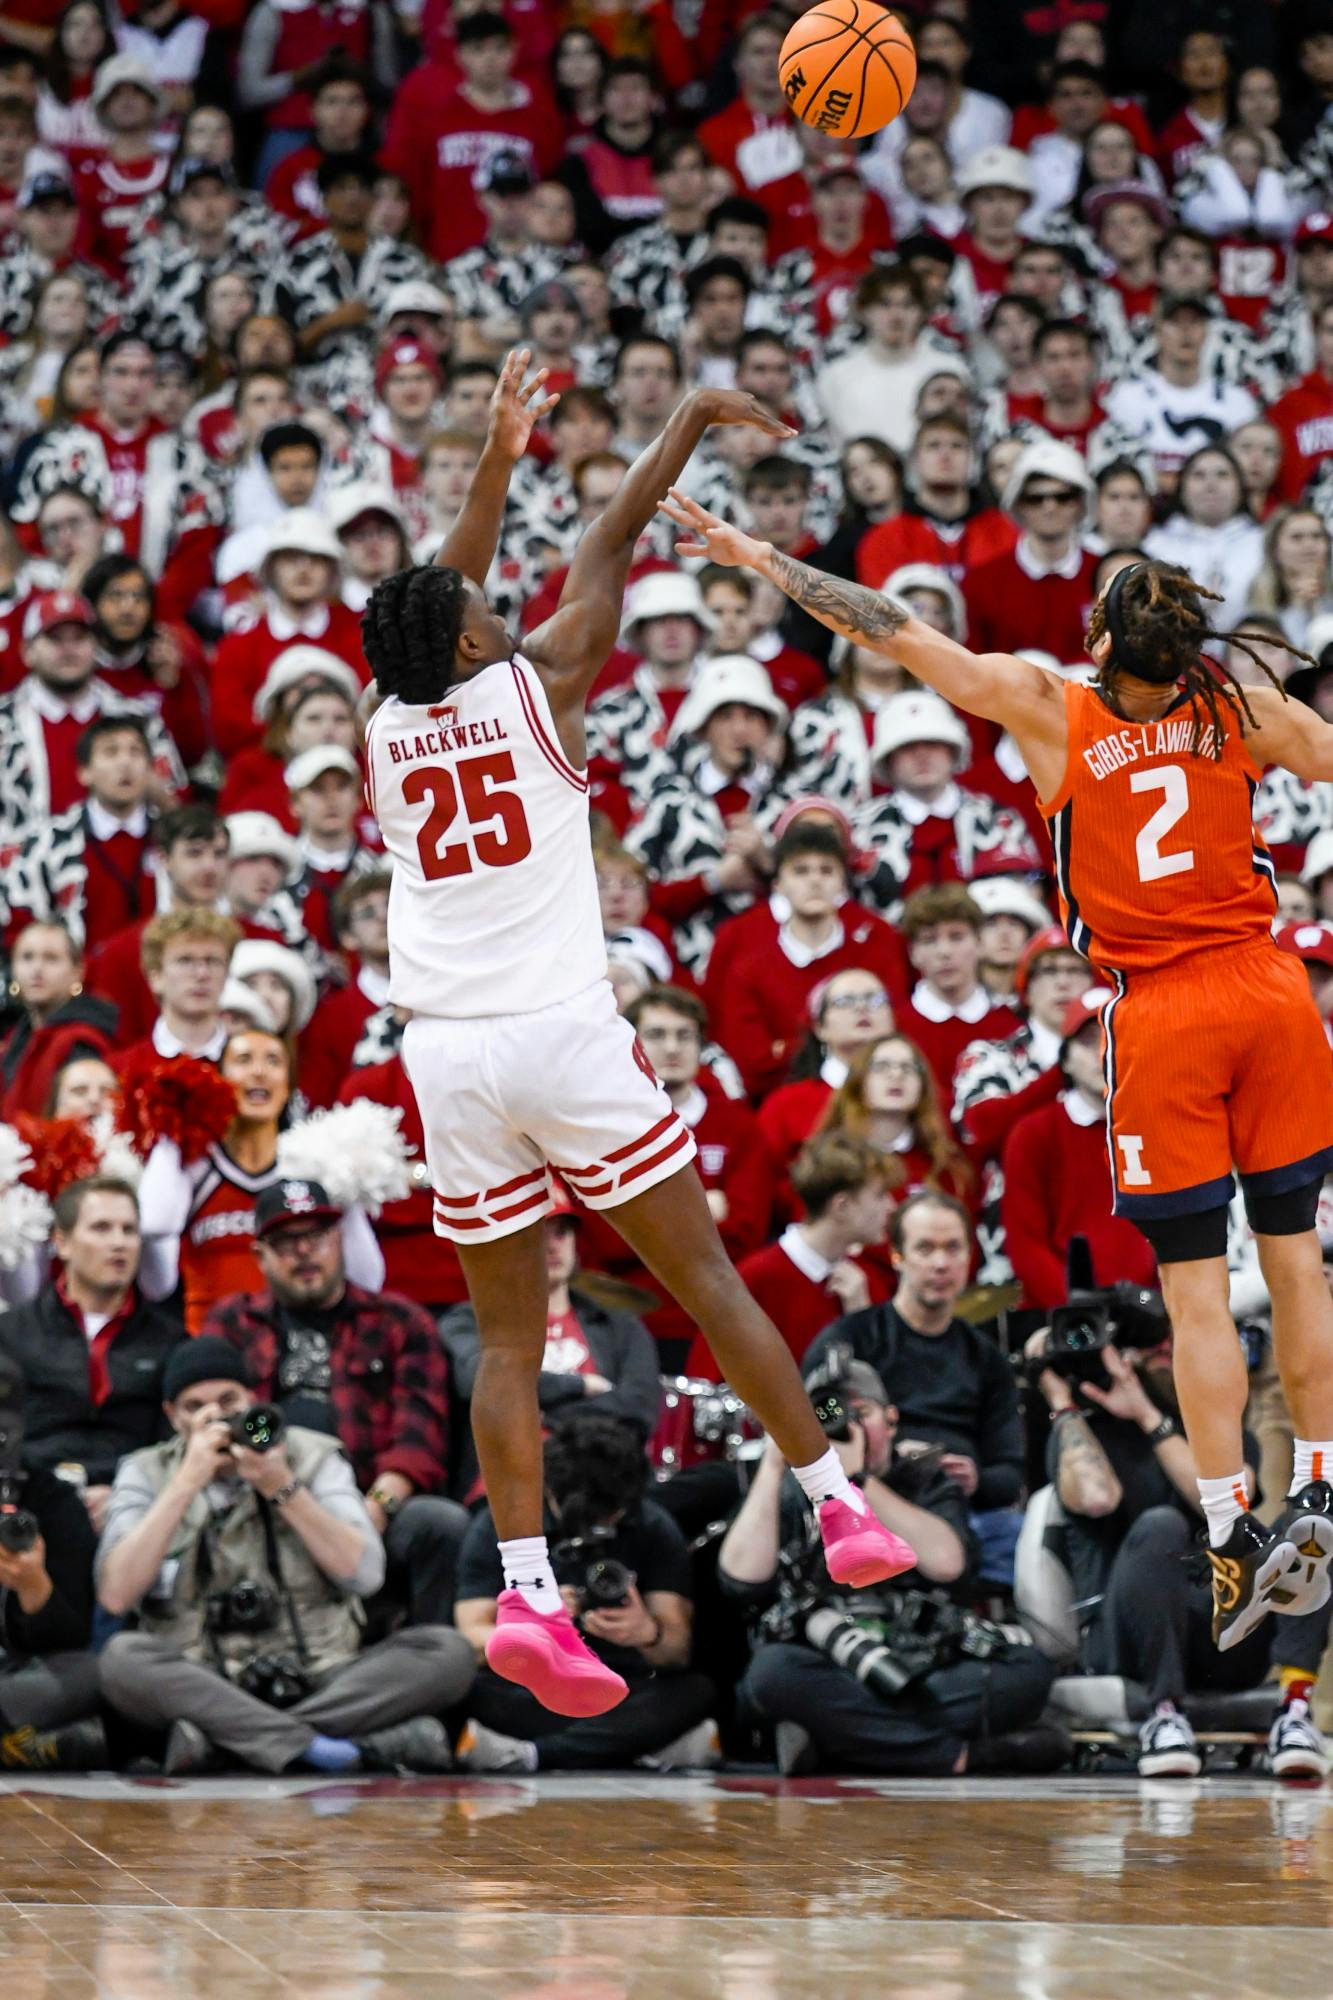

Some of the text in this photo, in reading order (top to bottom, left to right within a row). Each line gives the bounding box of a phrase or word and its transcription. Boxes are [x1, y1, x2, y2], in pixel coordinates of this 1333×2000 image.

[388, 718, 508, 764] BLACKWELL
[1082, 720, 1230, 781] GIBBS-LAWHR
[401, 750, 532, 881] 25
[1129, 764, 1195, 882] 2
[1117, 1134, 1152, 1186] I
